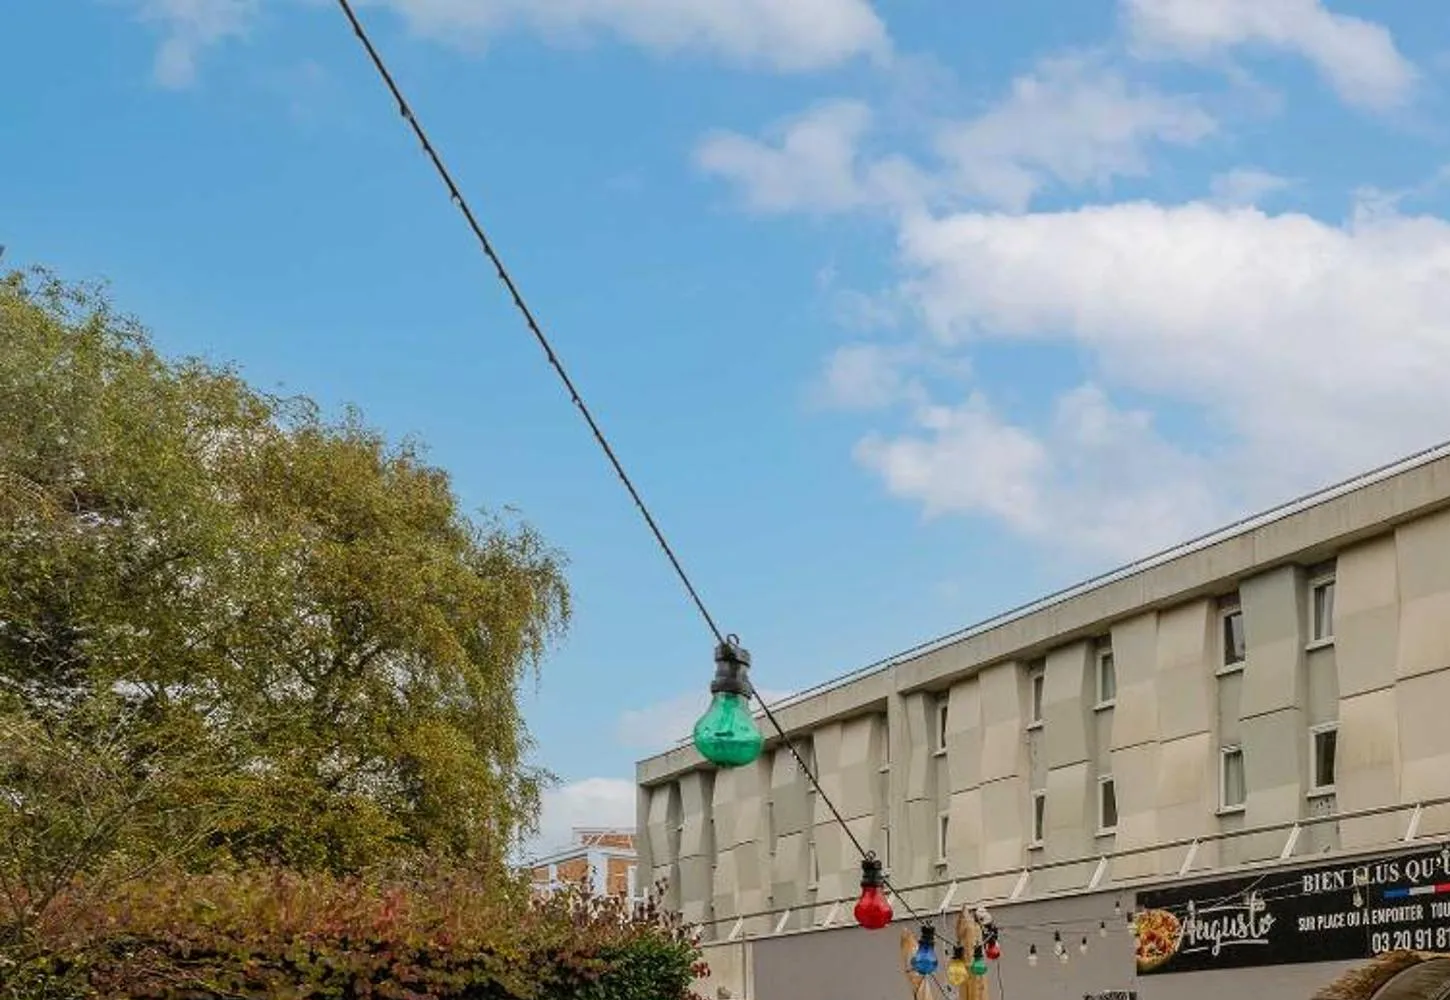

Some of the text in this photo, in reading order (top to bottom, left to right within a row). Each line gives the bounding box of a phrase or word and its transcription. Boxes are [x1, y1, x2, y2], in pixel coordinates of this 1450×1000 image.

[1302, 869, 1346, 893] BIEN
[1174, 889, 1277, 956] Augusto
[1298, 916, 1316, 932] SUR
[1317, 912, 1346, 931] PLACE
[1347, 911, 1360, 927] OU
[1371, 903, 1424, 925] EMPORTER
[1372, 931, 1390, 954] 03
[1393, 929, 1412, 951] 20
[1414, 927, 1432, 950] 91
